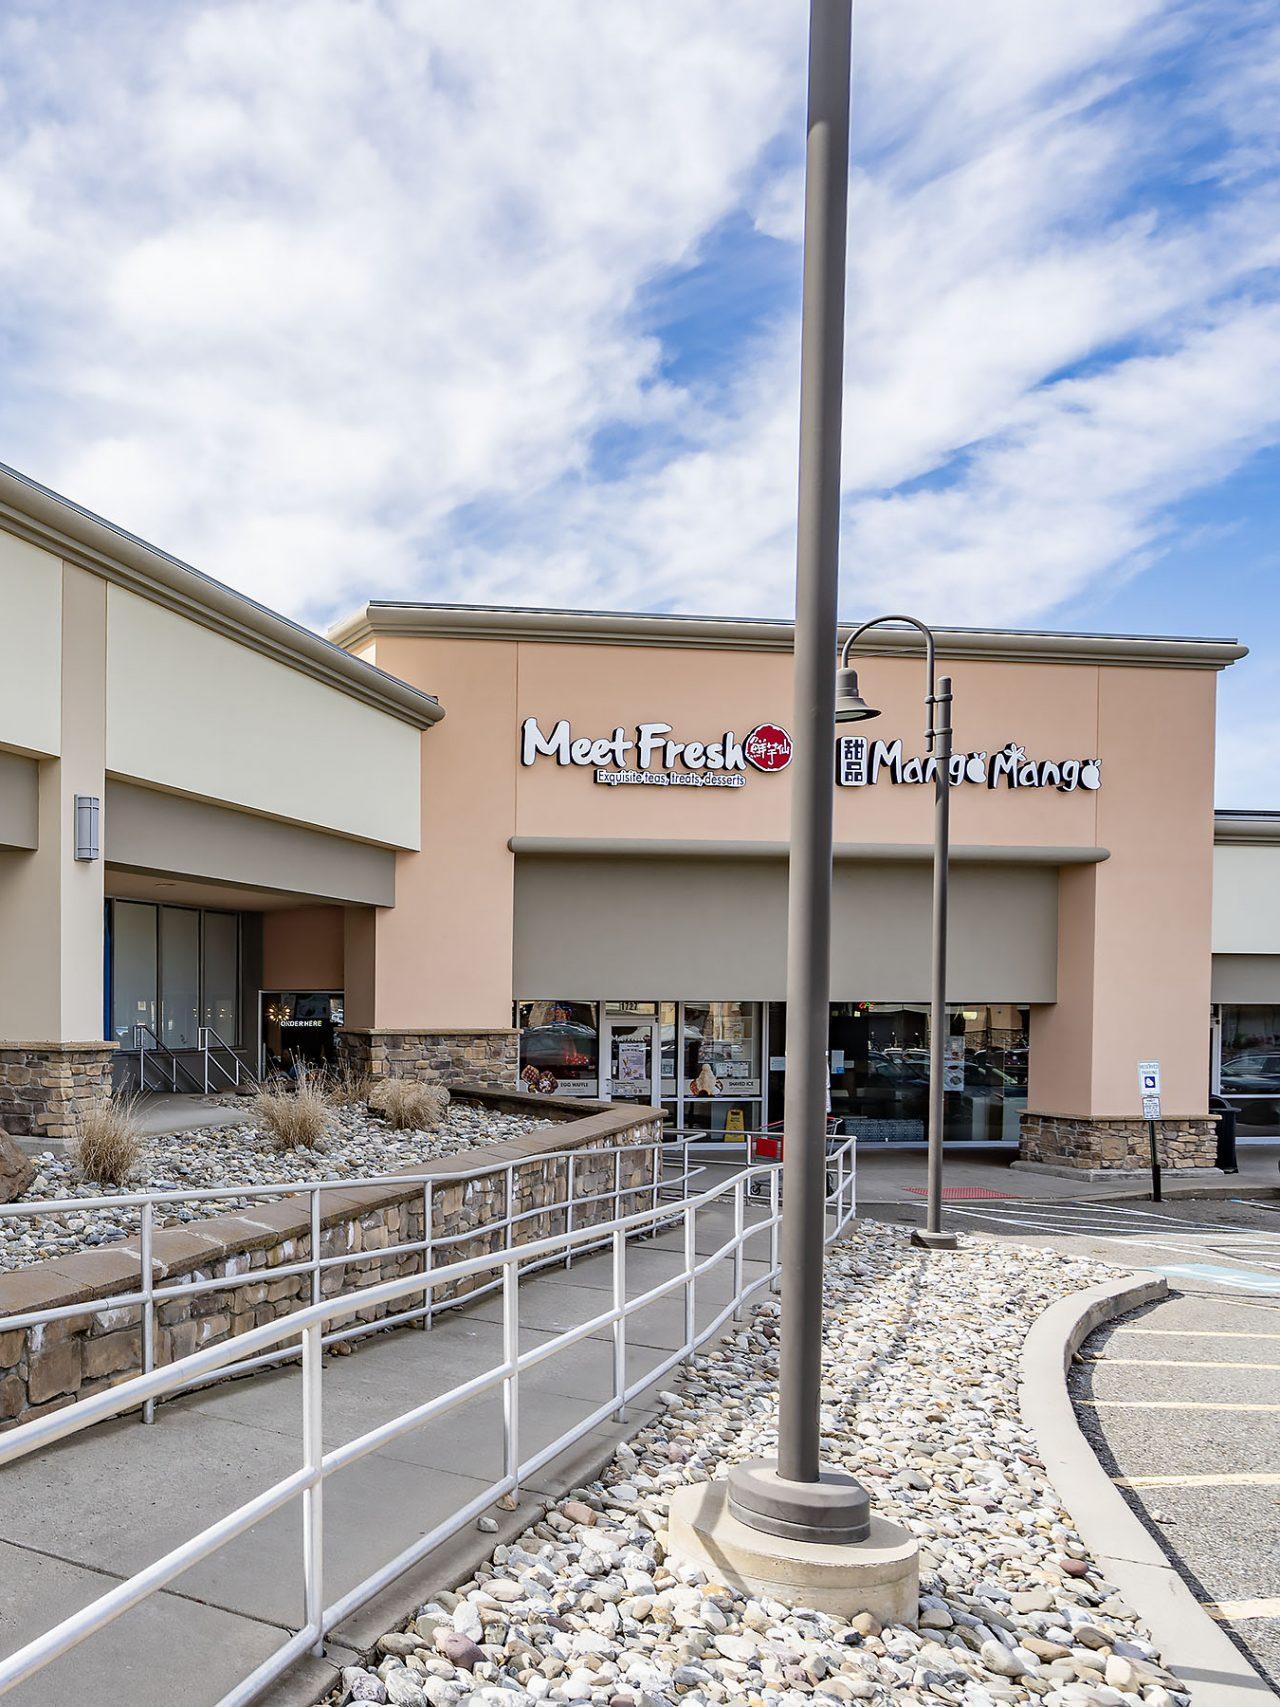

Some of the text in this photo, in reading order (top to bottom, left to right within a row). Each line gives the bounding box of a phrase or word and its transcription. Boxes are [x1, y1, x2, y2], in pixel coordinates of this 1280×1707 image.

[523, 717, 747, 771] Meet Fresh
[749, 736, 791, 766] 鮮芋仙
[597, 769, 745, 786] Exquisite teas, treats, desserts
[991, 743, 1102, 791] Mango
